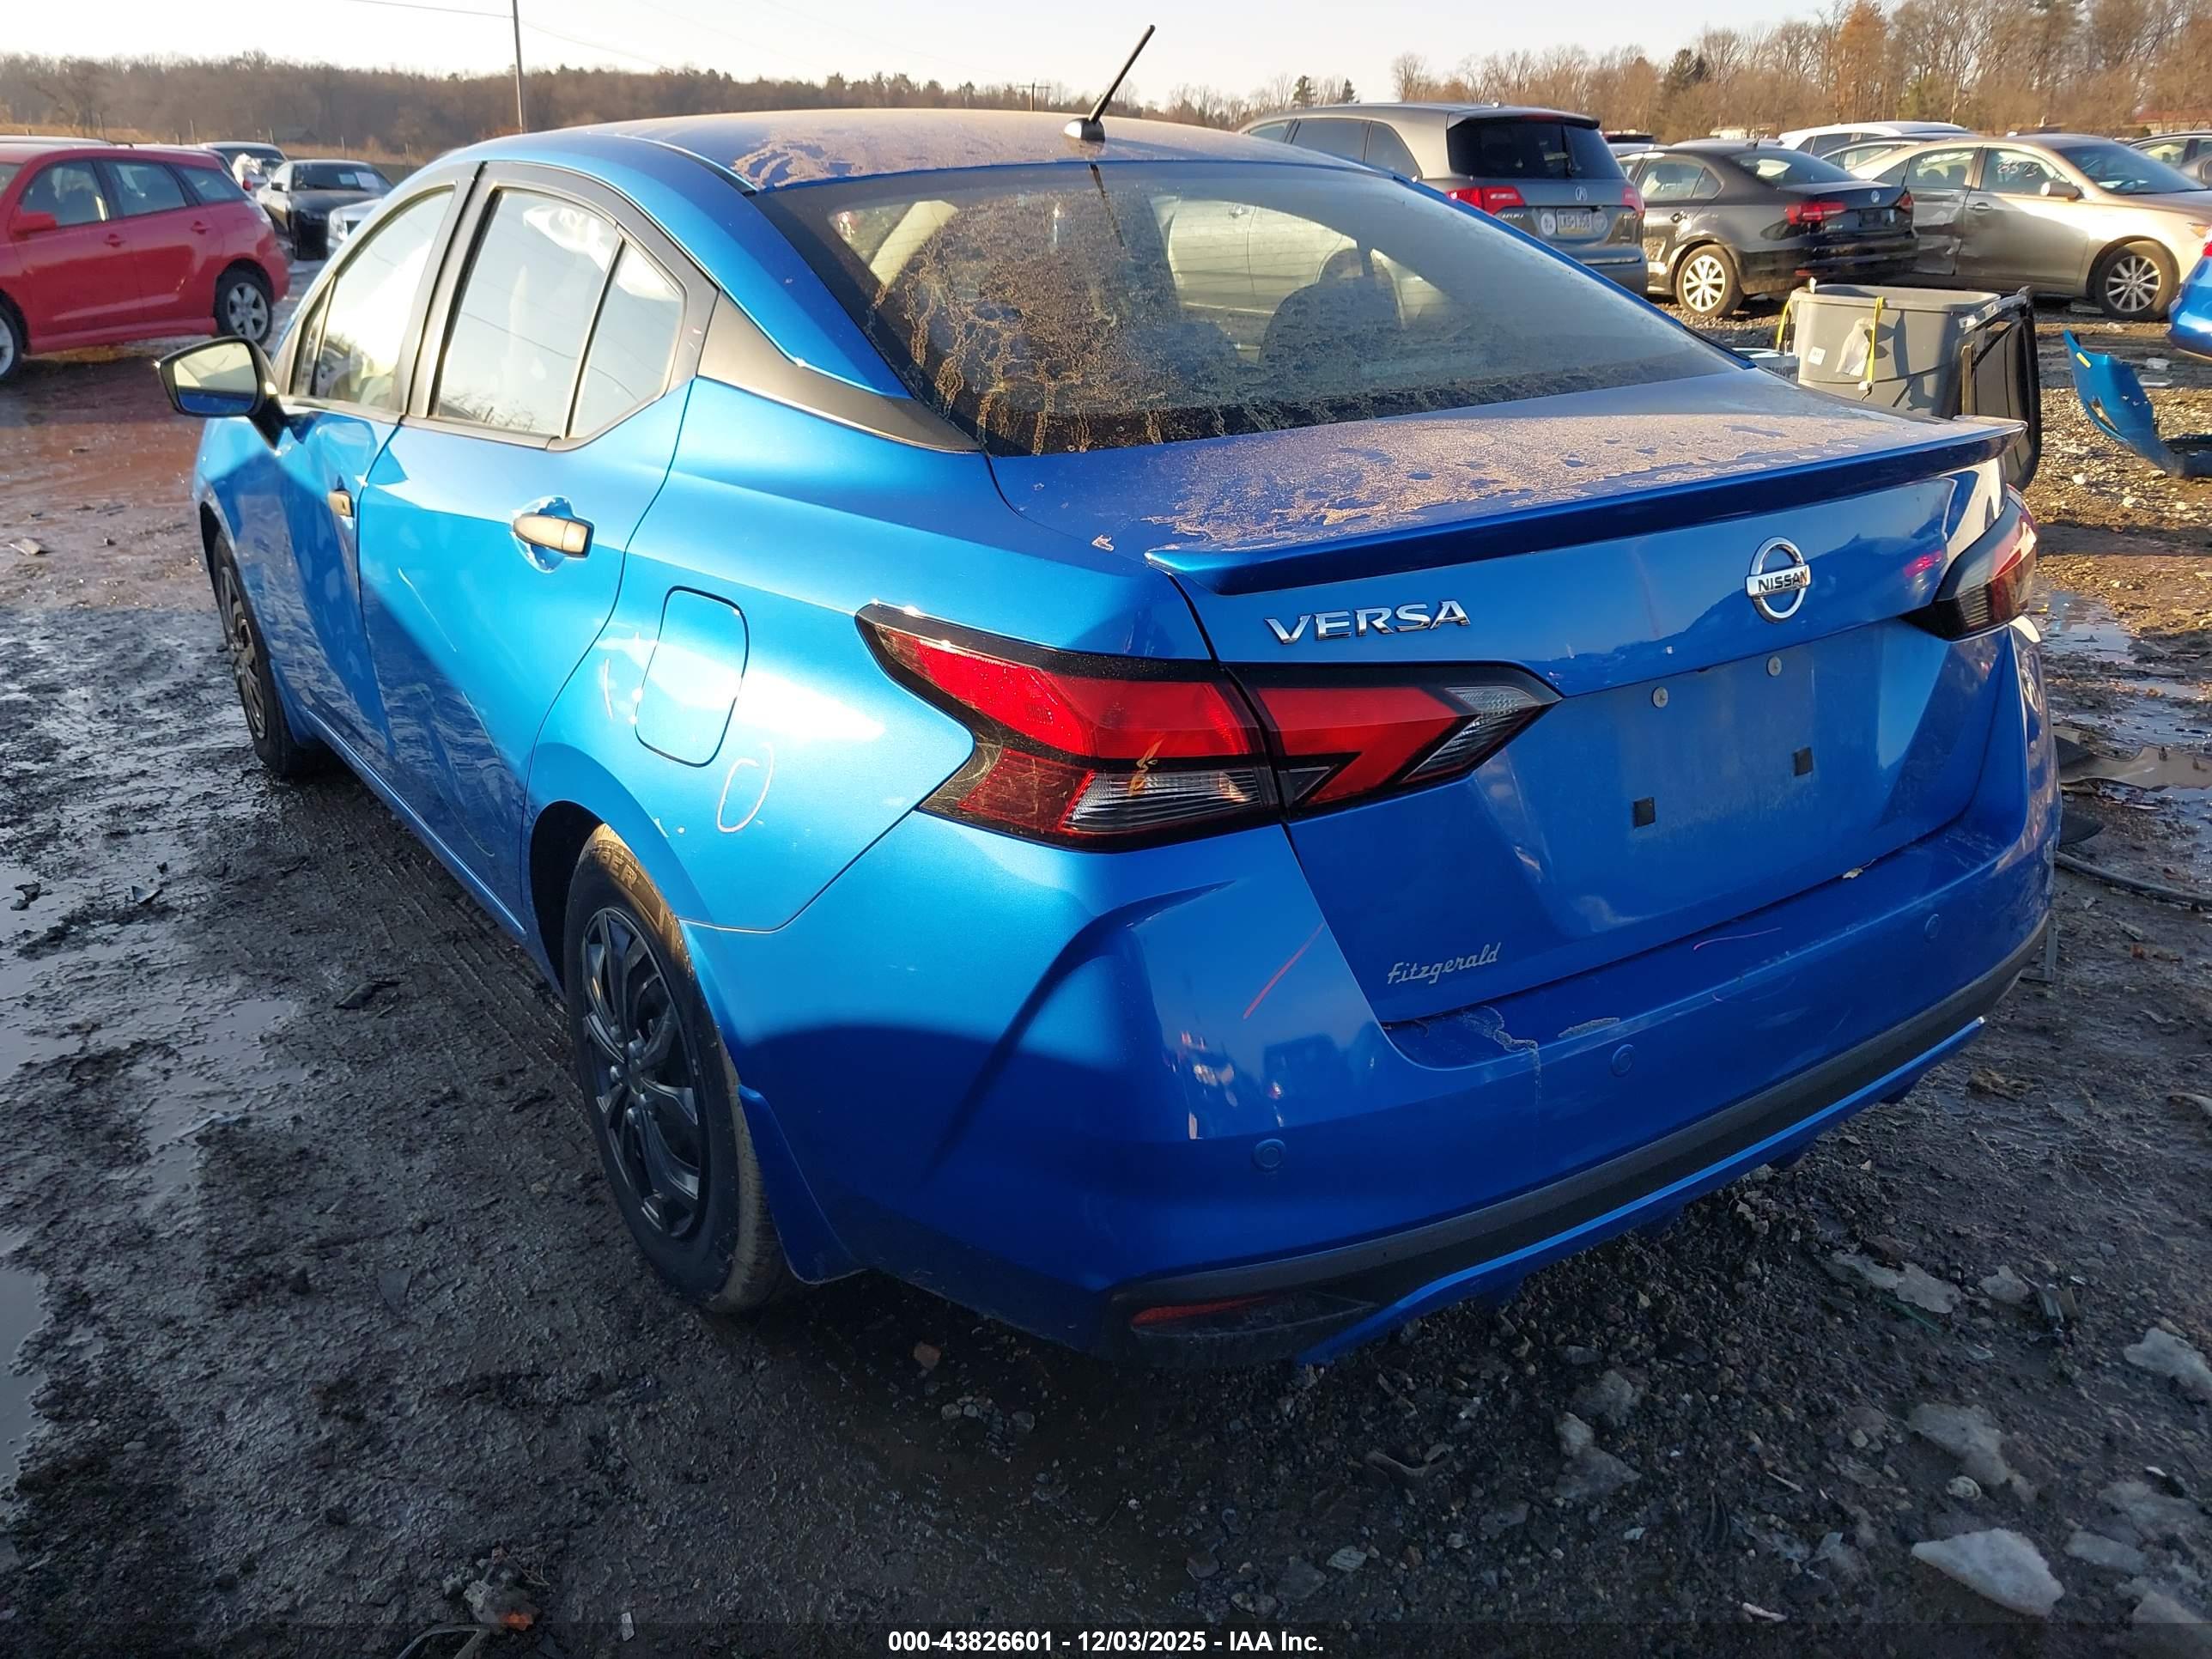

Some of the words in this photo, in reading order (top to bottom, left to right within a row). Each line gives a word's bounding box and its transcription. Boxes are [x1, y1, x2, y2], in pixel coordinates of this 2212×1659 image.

[1758, 568, 1808, 592] NISSAN
[1264, 599, 1471, 645] VERSA
[1387, 941, 1502, 985] Fitzgerald
